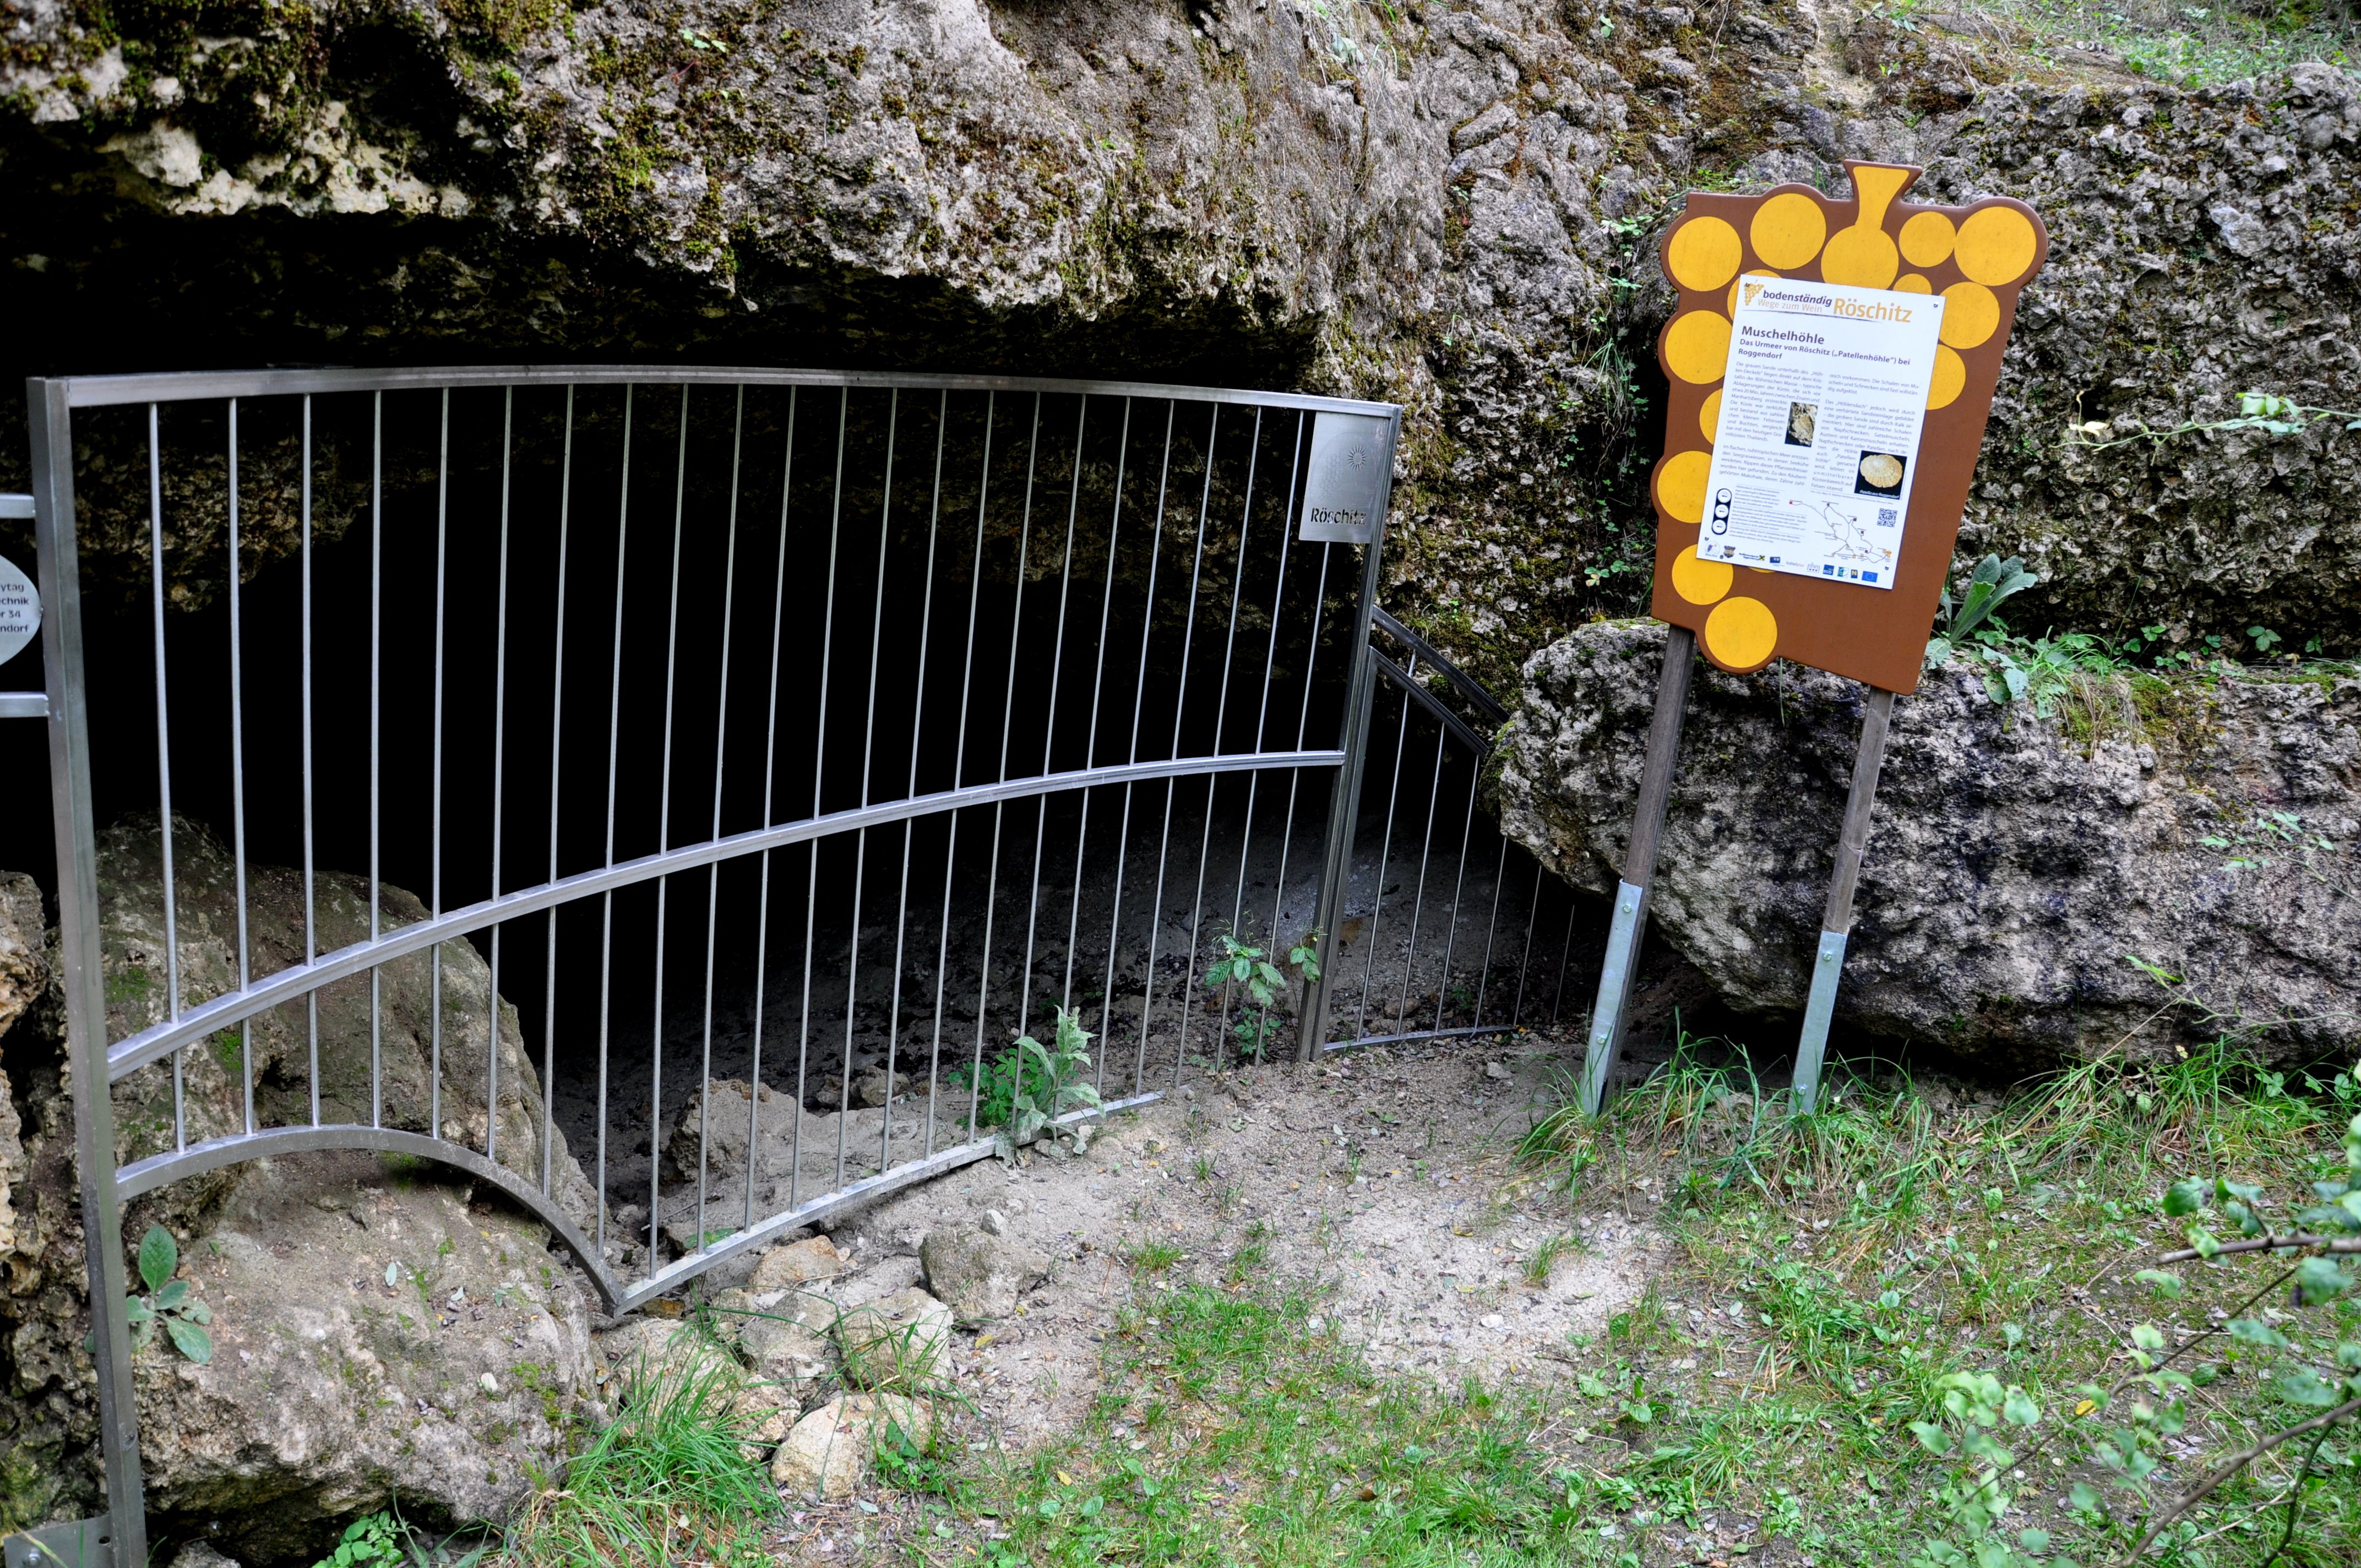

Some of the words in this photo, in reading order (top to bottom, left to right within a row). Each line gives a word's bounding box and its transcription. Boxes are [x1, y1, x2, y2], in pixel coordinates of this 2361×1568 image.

[1758, 298, 1780, 309] Wege
[1782, 302, 1799, 310] zum
[1802, 303, 1822, 313] Wein
[1763, 290, 1832, 307] bodenständig
[1834, 298, 1912, 322] Röschitz
[1742, 326, 1824, 344] Muschelhöhle
[1738, 348, 1782, 359] Roggendorf
[1755, 340, 1782, 349] Urmeer
[1799, 346, 1830, 355] Röschitz
[1310, 507, 1367, 526] Röschitz
[0, 597, 29, 605] chnik
[9, 610, 21, 619] 34
